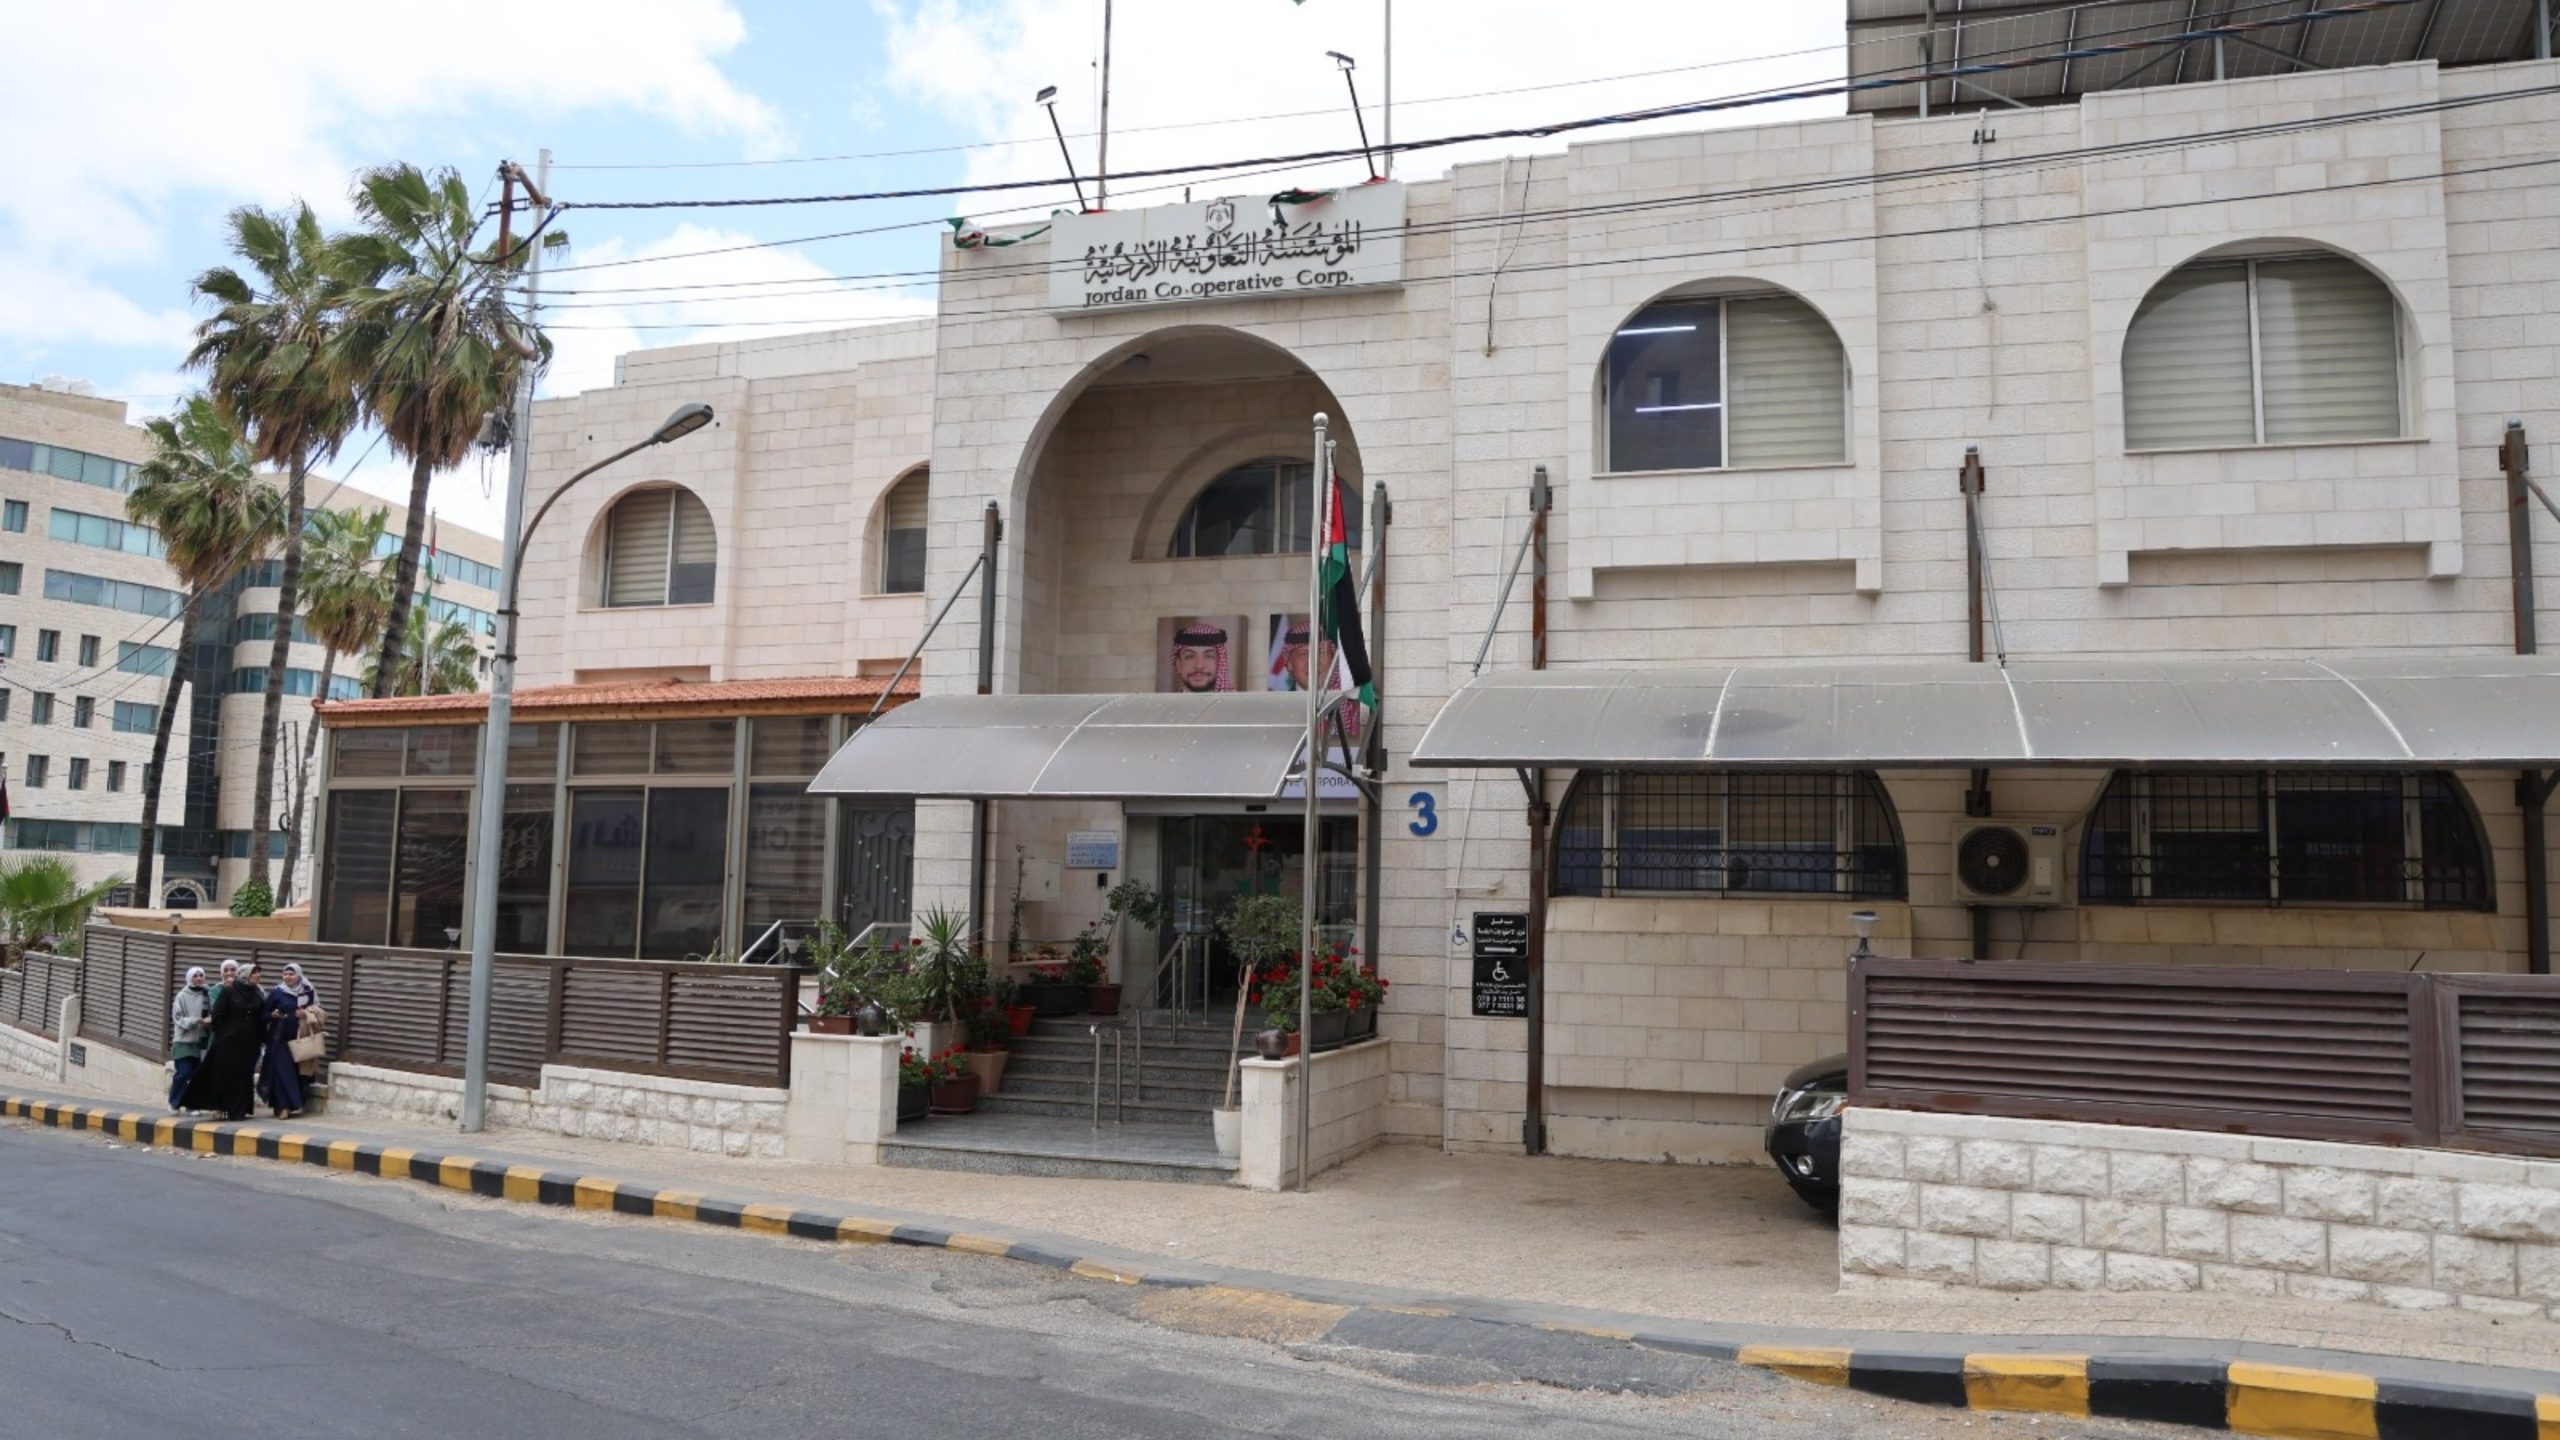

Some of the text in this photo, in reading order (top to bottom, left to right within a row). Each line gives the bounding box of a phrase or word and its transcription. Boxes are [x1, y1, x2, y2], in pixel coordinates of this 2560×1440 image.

[1083, 286, 1147, 308] Jordan
[1297, 269, 1353, 288] Corp.
[1408, 791, 1438, 837] 3
